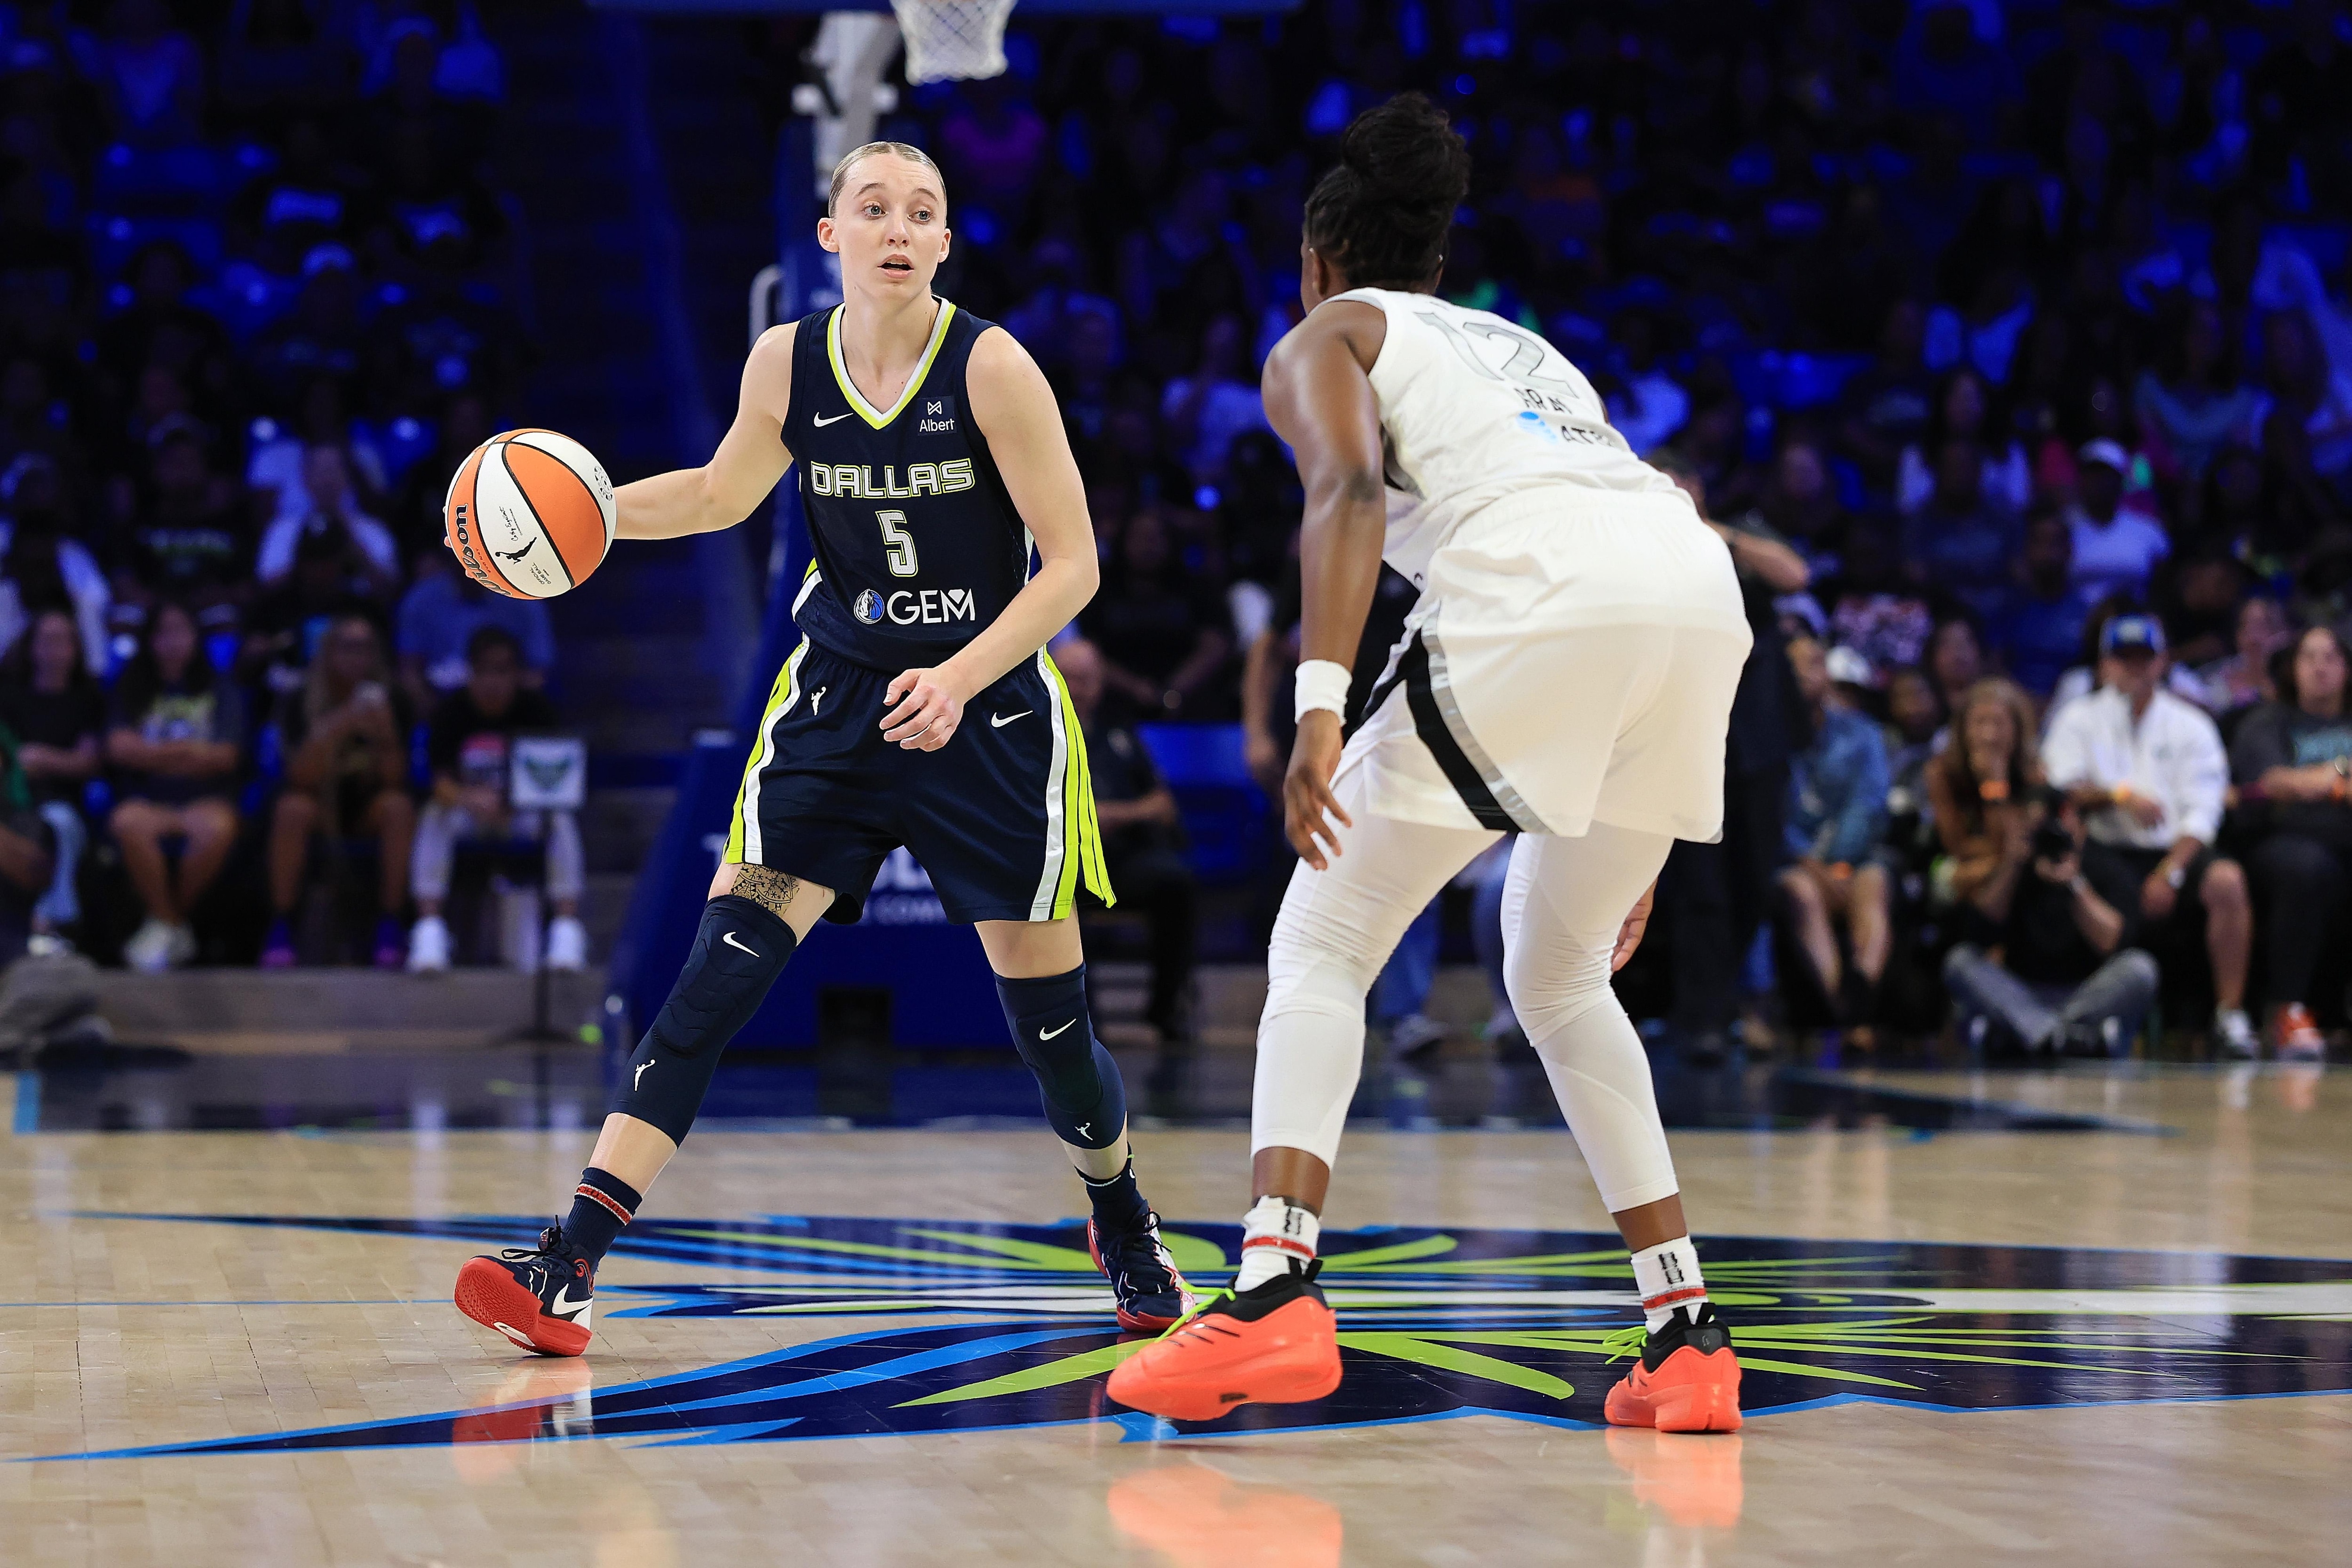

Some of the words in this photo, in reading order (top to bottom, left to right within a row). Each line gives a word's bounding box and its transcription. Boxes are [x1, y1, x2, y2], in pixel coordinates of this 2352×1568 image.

[919, 418, 954, 432] Albert
[810, 458, 975, 499] DALLAS
[875, 509, 918, 577] 5
[532, 562, 542, 574] BALL
[886, 589, 975, 625] GEM
